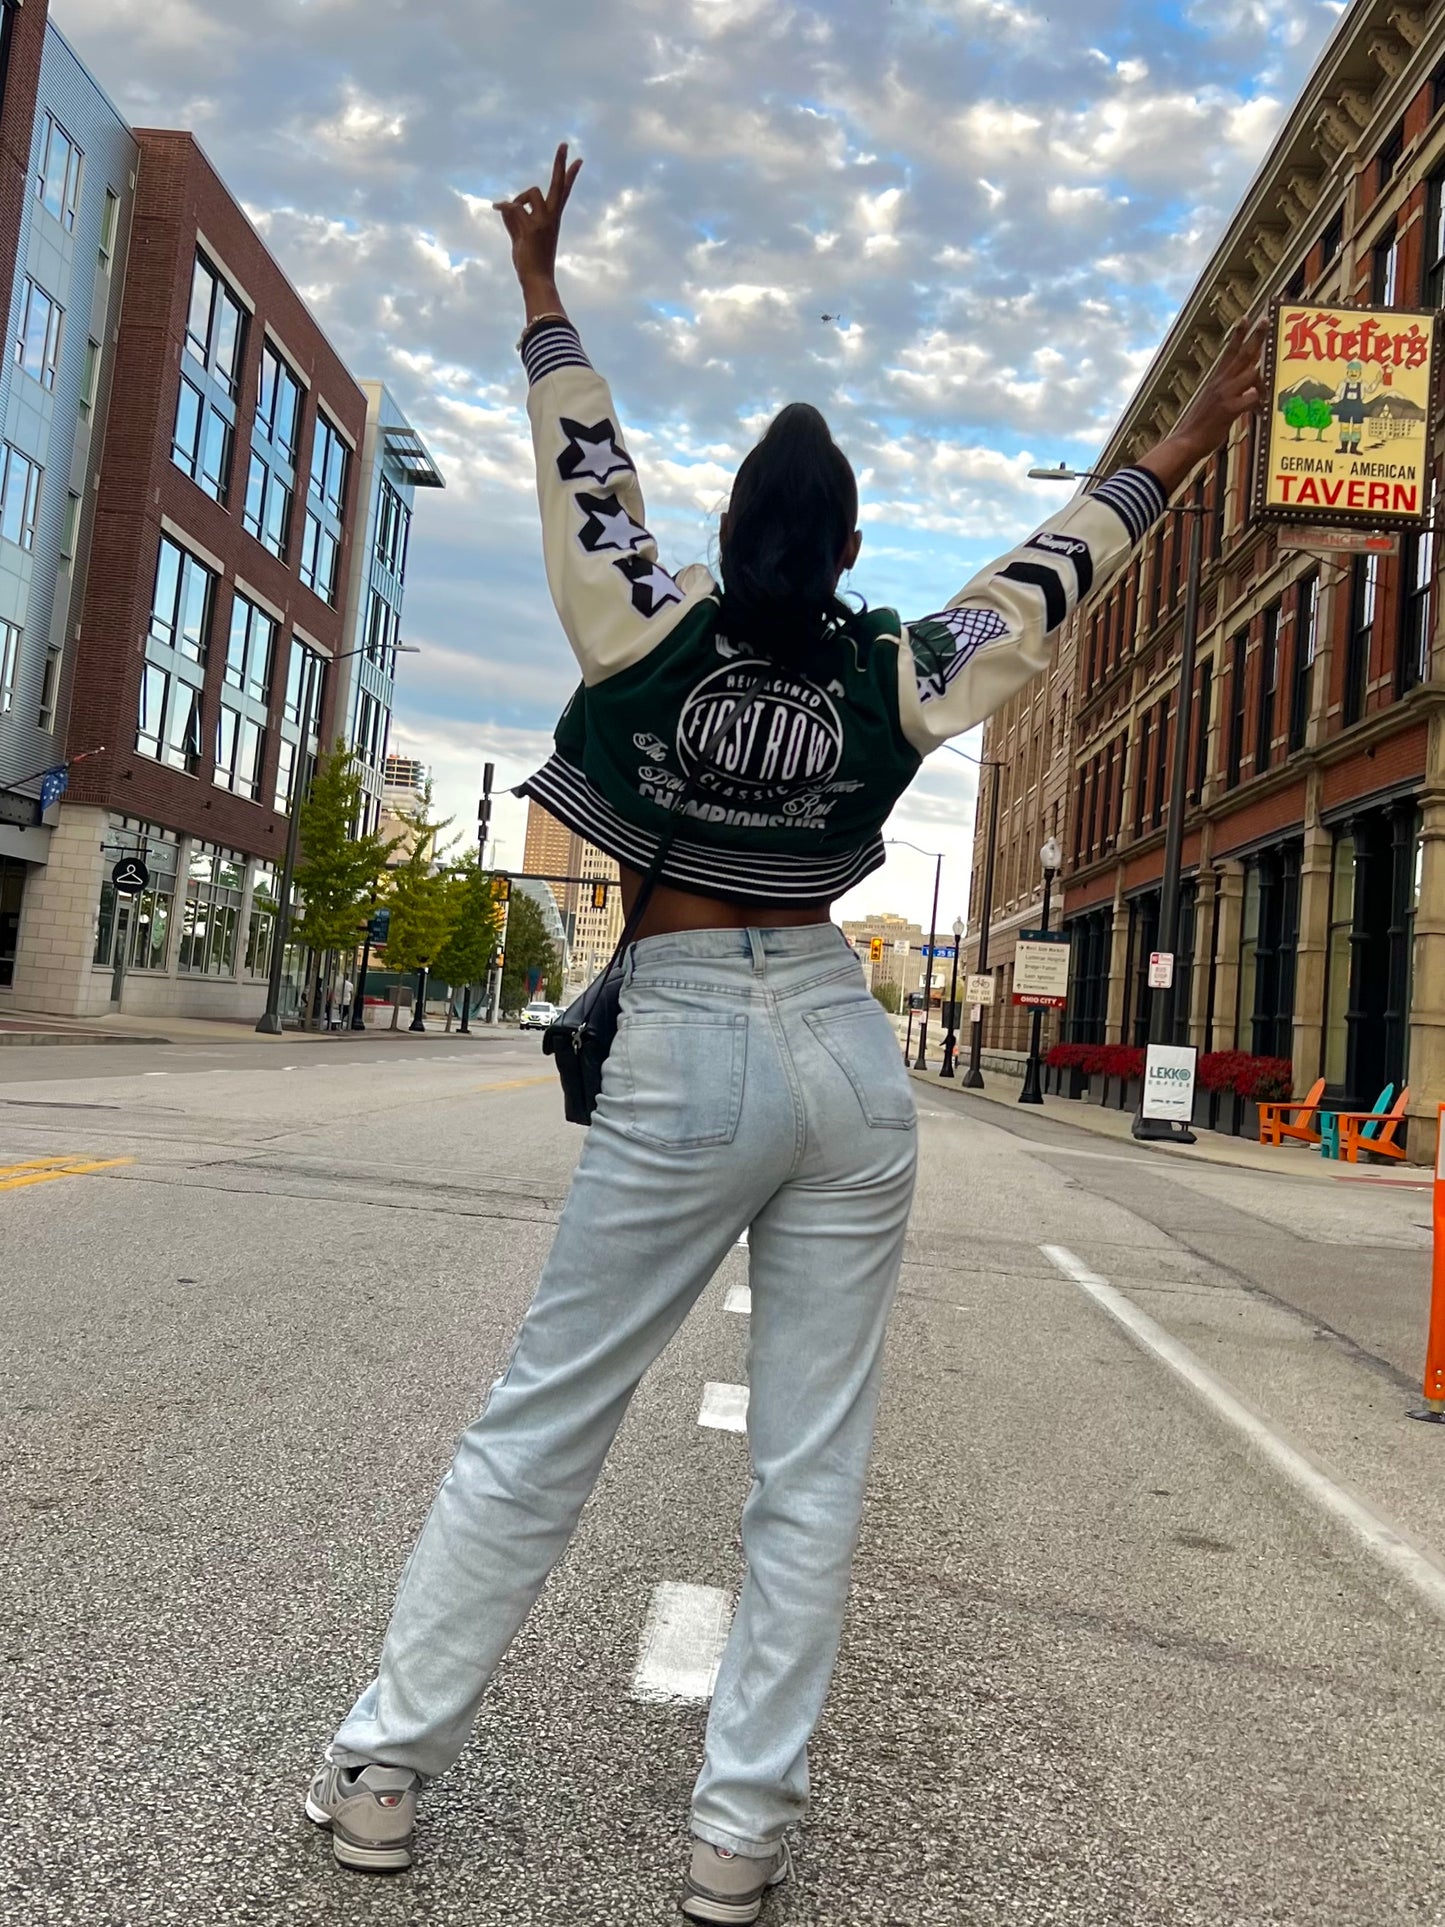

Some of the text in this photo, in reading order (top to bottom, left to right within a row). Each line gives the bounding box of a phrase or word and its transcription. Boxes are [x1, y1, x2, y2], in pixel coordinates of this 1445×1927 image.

[1282, 312, 1429, 370] Kiefer's
[1281, 456, 1334, 473] GERMAN
[1350, 461, 1416, 480] AMERICAN
[1276, 475, 1416, 511] TAVERN
[758, 704, 832, 781] ROW
[699, 772, 790, 801] CLASSIC
[1020, 996, 1058, 1006] OHIO CITY
[1150, 1066, 1191, 1081] LEKKO
